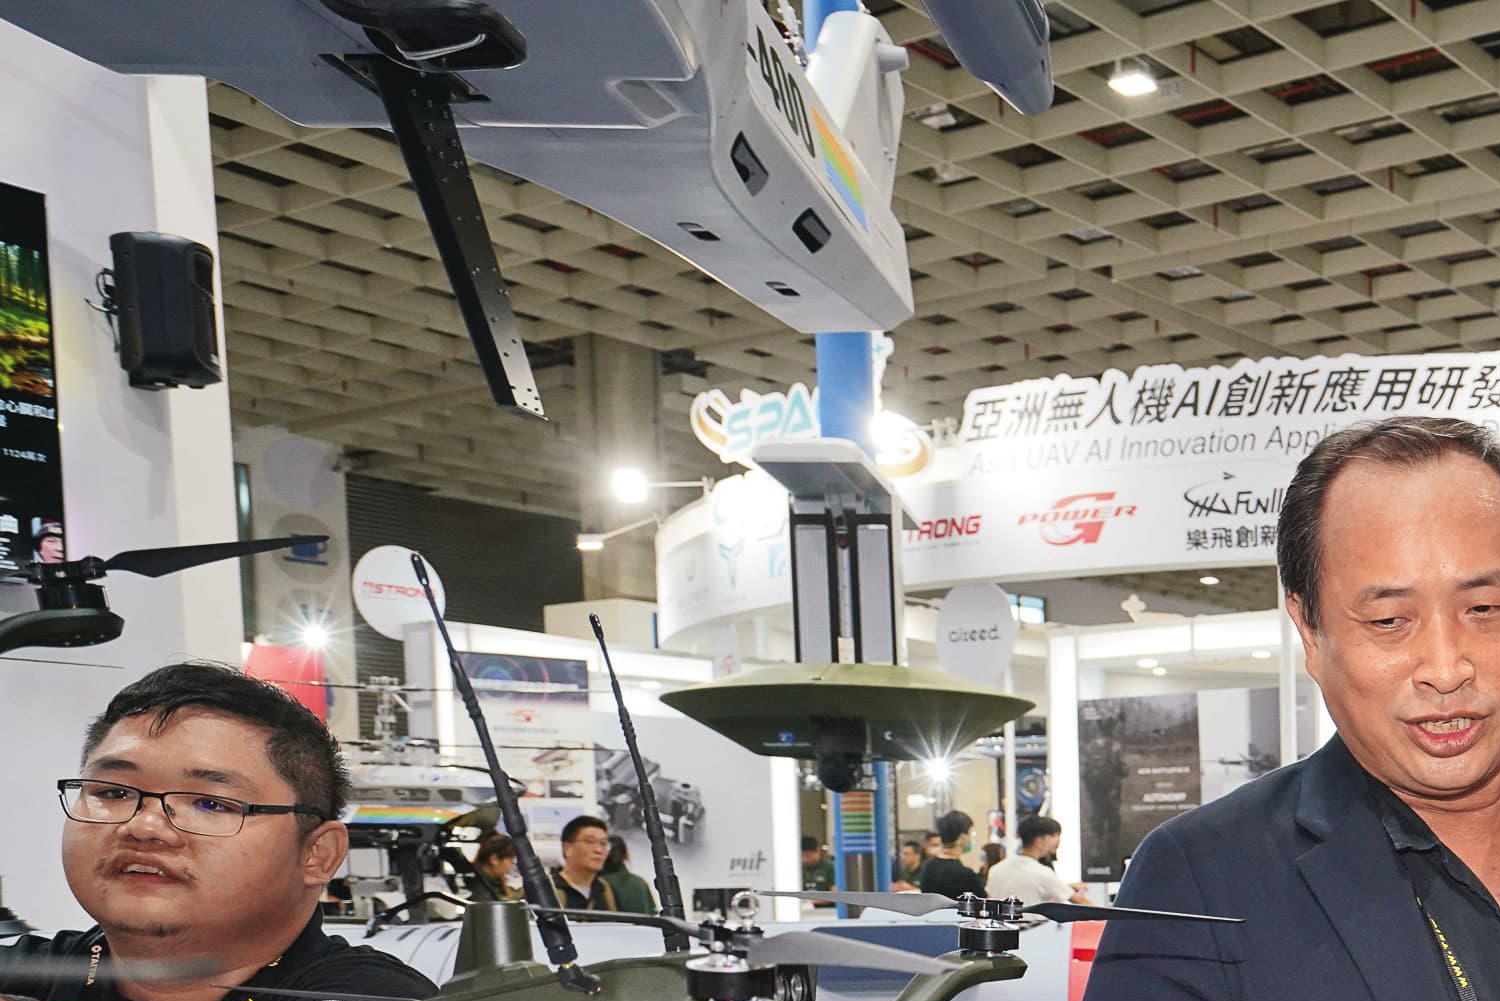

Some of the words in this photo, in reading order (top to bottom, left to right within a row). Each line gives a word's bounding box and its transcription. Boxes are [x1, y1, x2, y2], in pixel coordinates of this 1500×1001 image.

[726, 391, 821, 452] SPA
[1026, 440, 1075, 469] UAV
[1084, 436, 1112, 464] AI
[1120, 428, 1256, 459] Innovation
